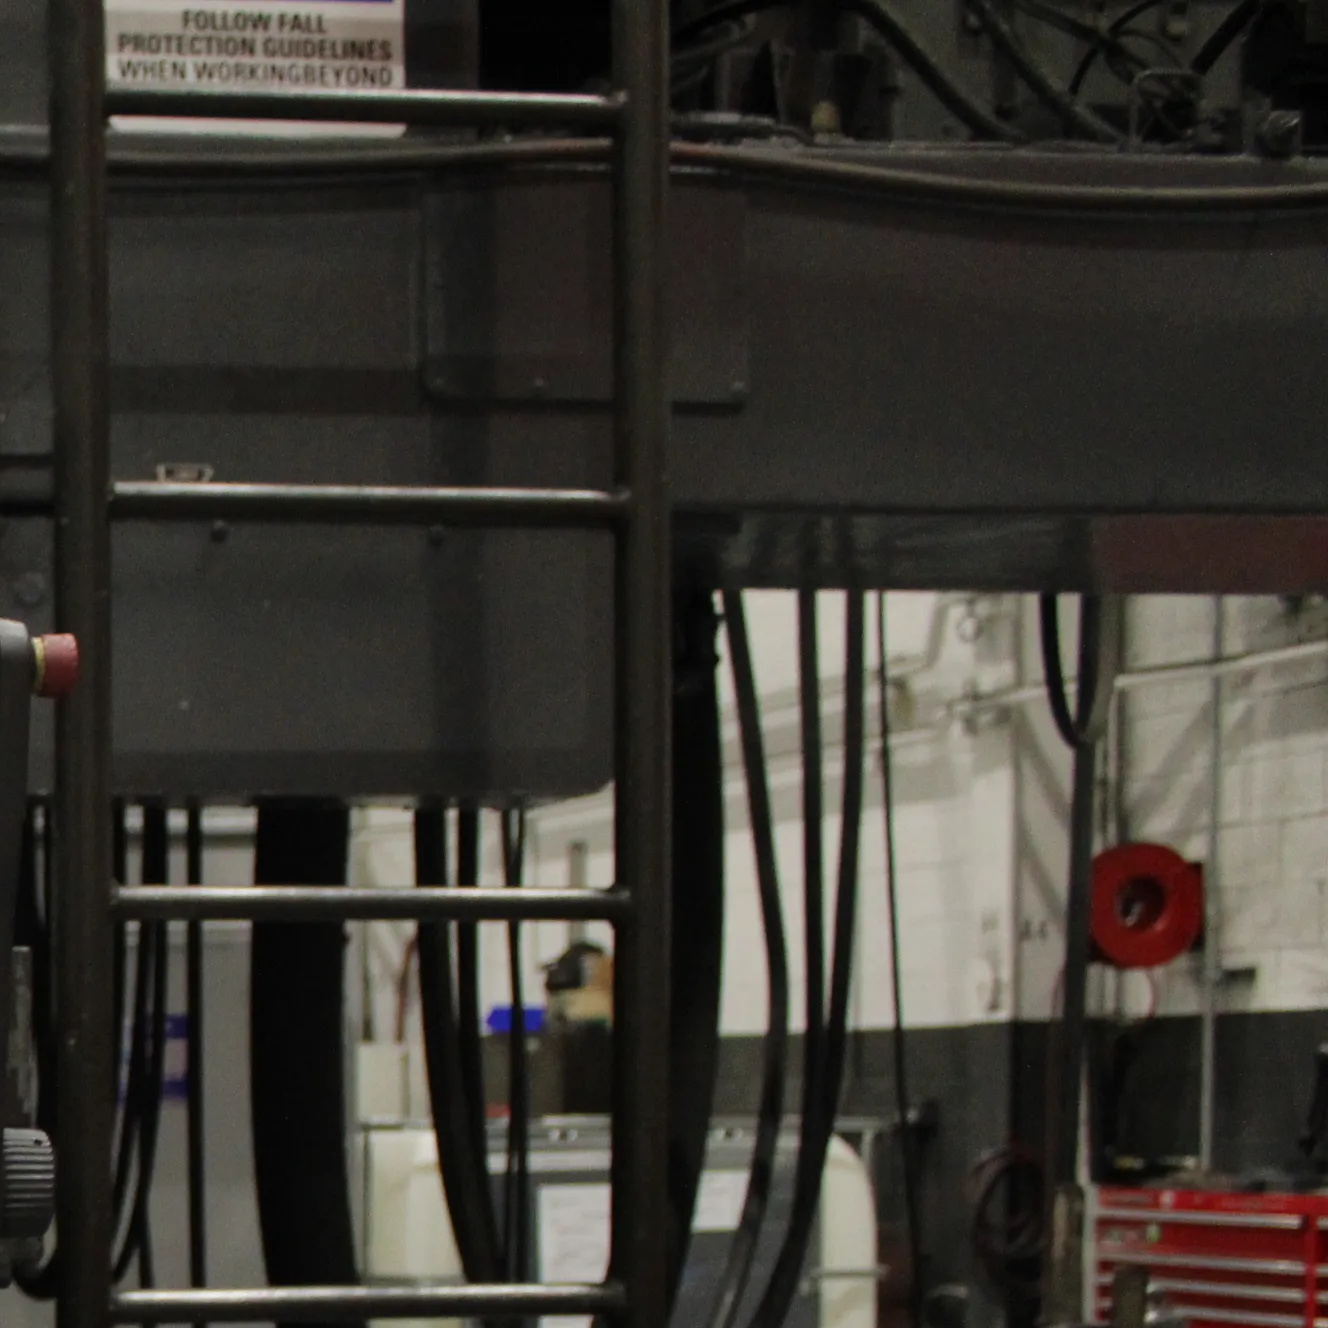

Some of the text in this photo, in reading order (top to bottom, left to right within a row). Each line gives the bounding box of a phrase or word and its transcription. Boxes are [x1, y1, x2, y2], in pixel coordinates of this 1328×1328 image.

[182, 9, 326, 33] FOLLOW FALL
[117, 33, 393, 60] PROTECTION GUIDELINES
[118, 59, 186, 80] WHEN
